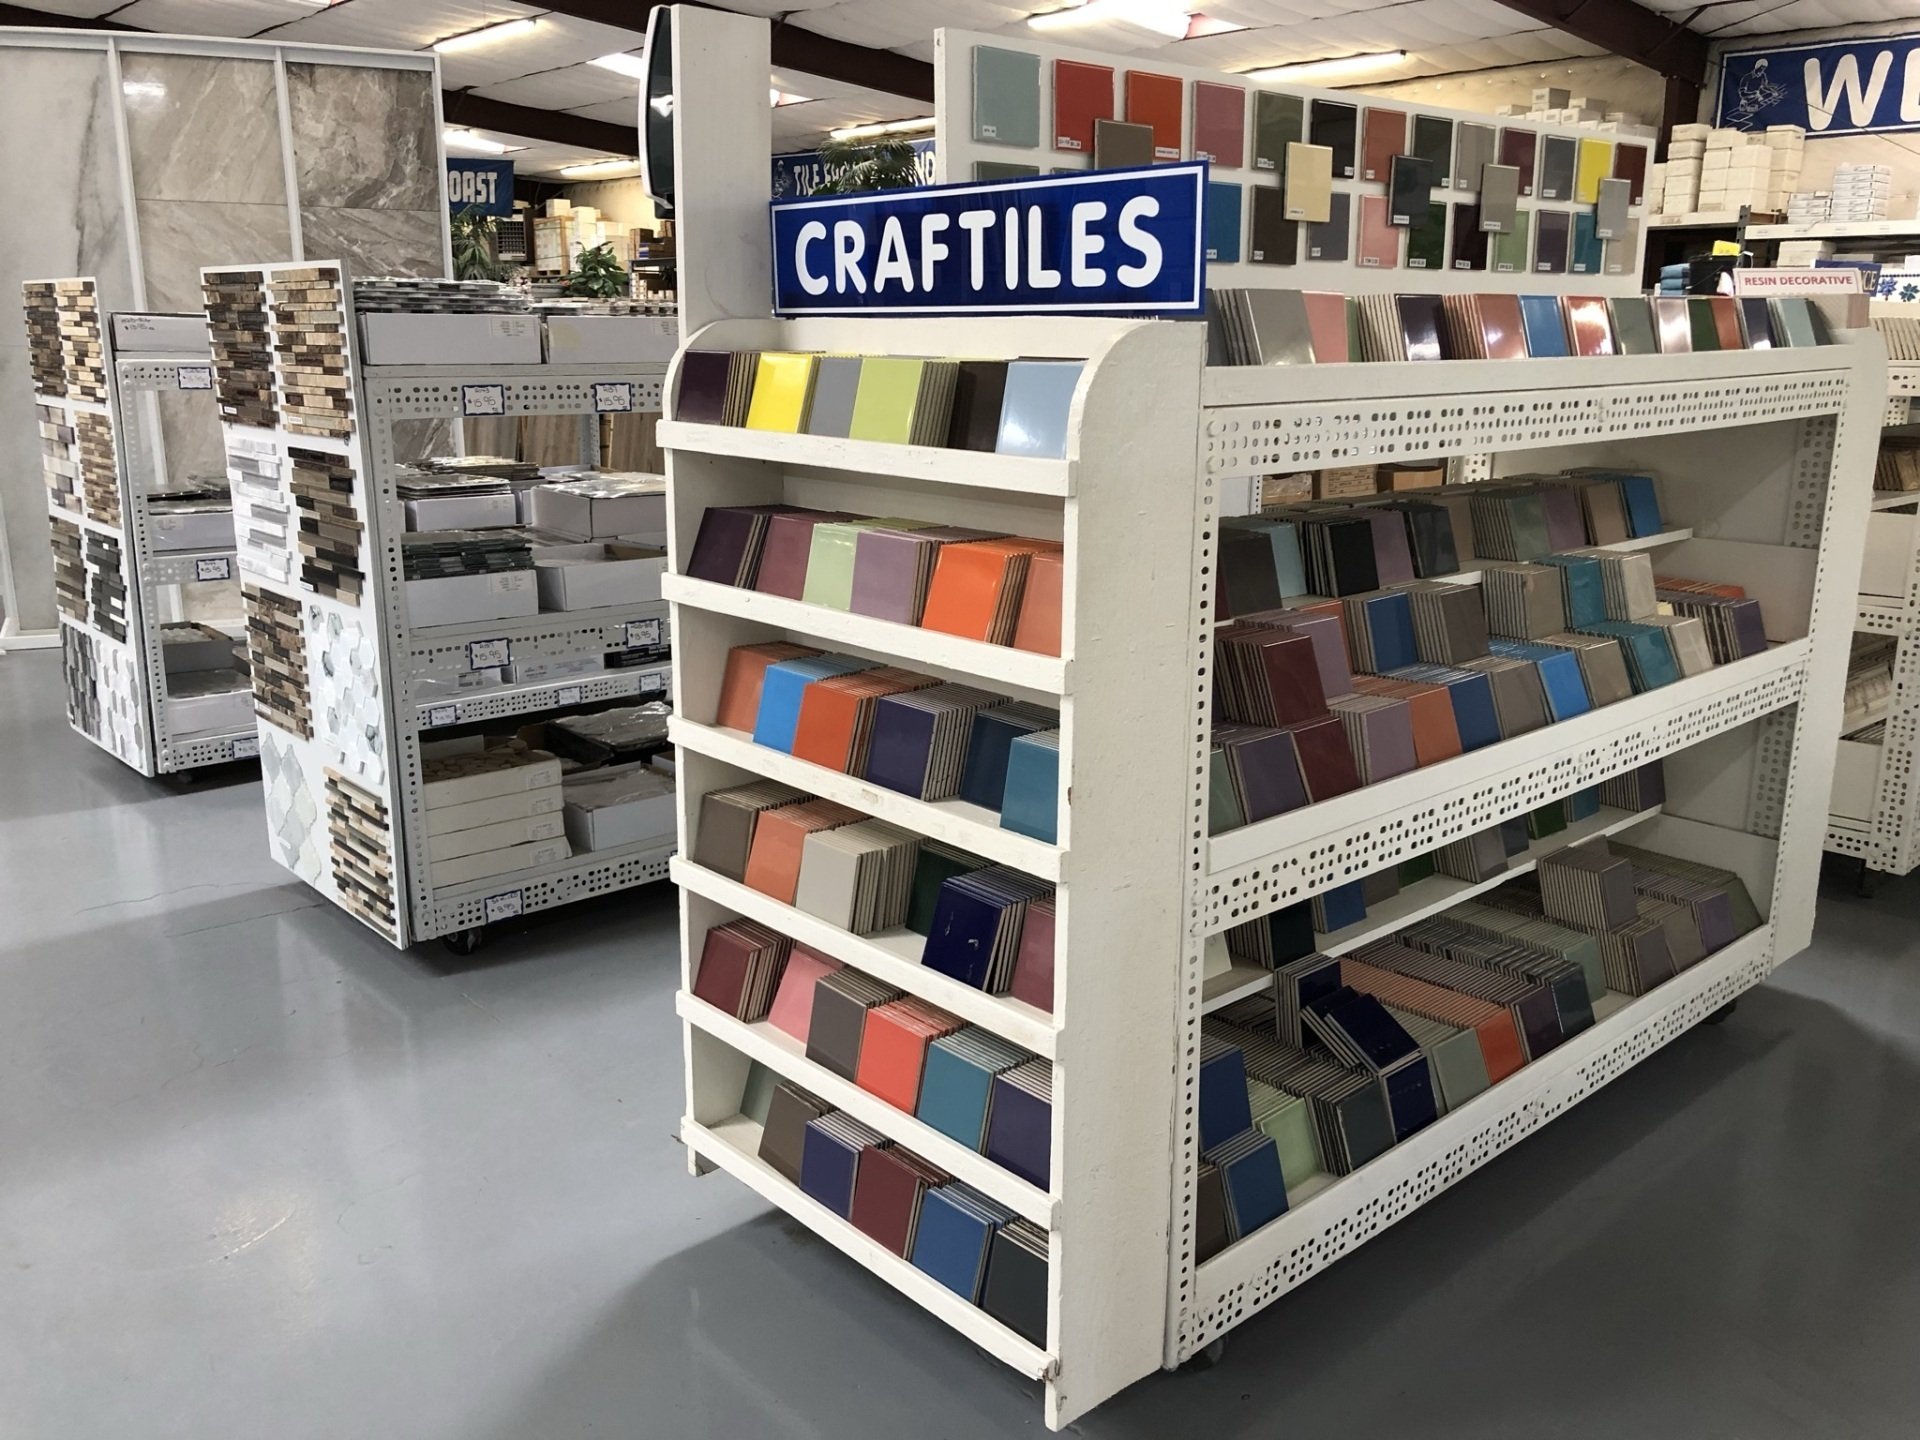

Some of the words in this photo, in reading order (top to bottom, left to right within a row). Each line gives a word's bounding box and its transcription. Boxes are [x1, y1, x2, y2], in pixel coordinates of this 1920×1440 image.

[449, 170, 498, 204] OAST
[795, 195, 1163, 296] CRAFTILES
[1744, 276, 1777, 286] RESIN
[1780, 275, 1853, 285] DECORATIVE
